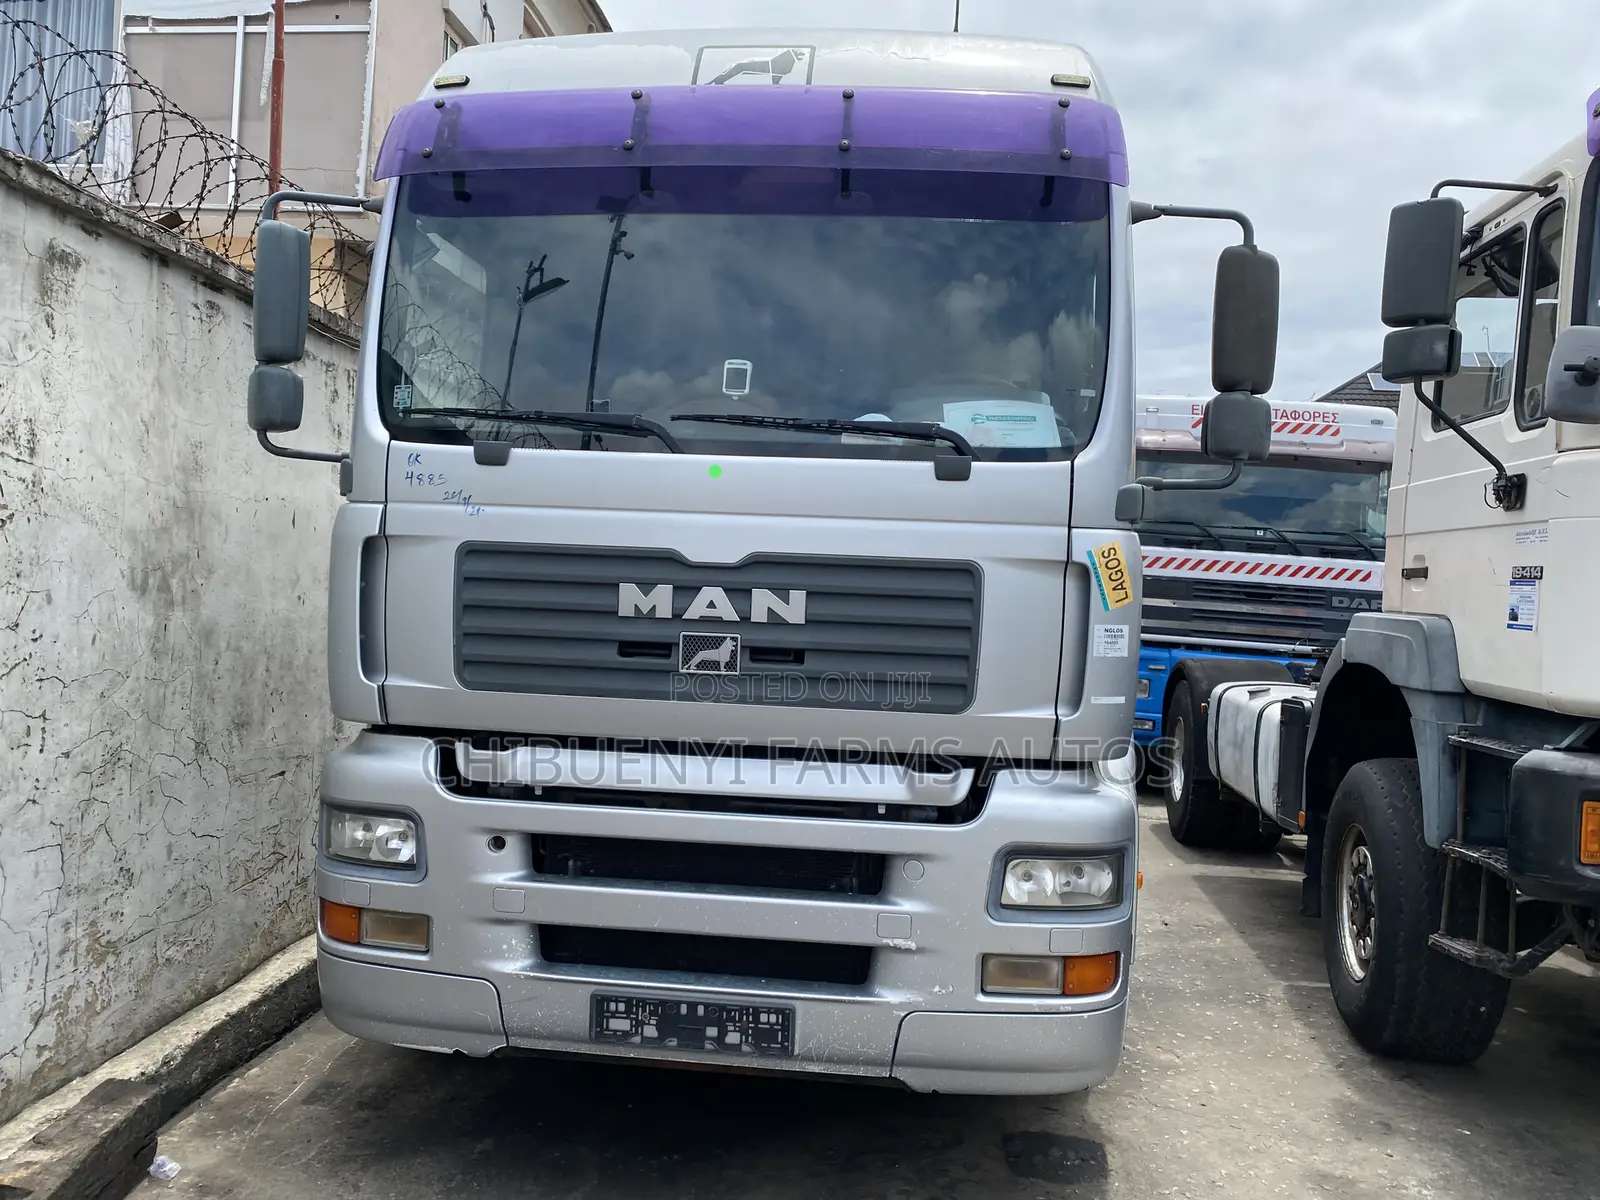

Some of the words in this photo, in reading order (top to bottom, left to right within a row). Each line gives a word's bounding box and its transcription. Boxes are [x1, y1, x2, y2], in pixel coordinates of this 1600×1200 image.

[1272, 408, 1340, 424] ΤΑΦΟΡΕΣ
[1101, 547, 1129, 603] LAGOS
[617, 582, 806, 625] MAN
